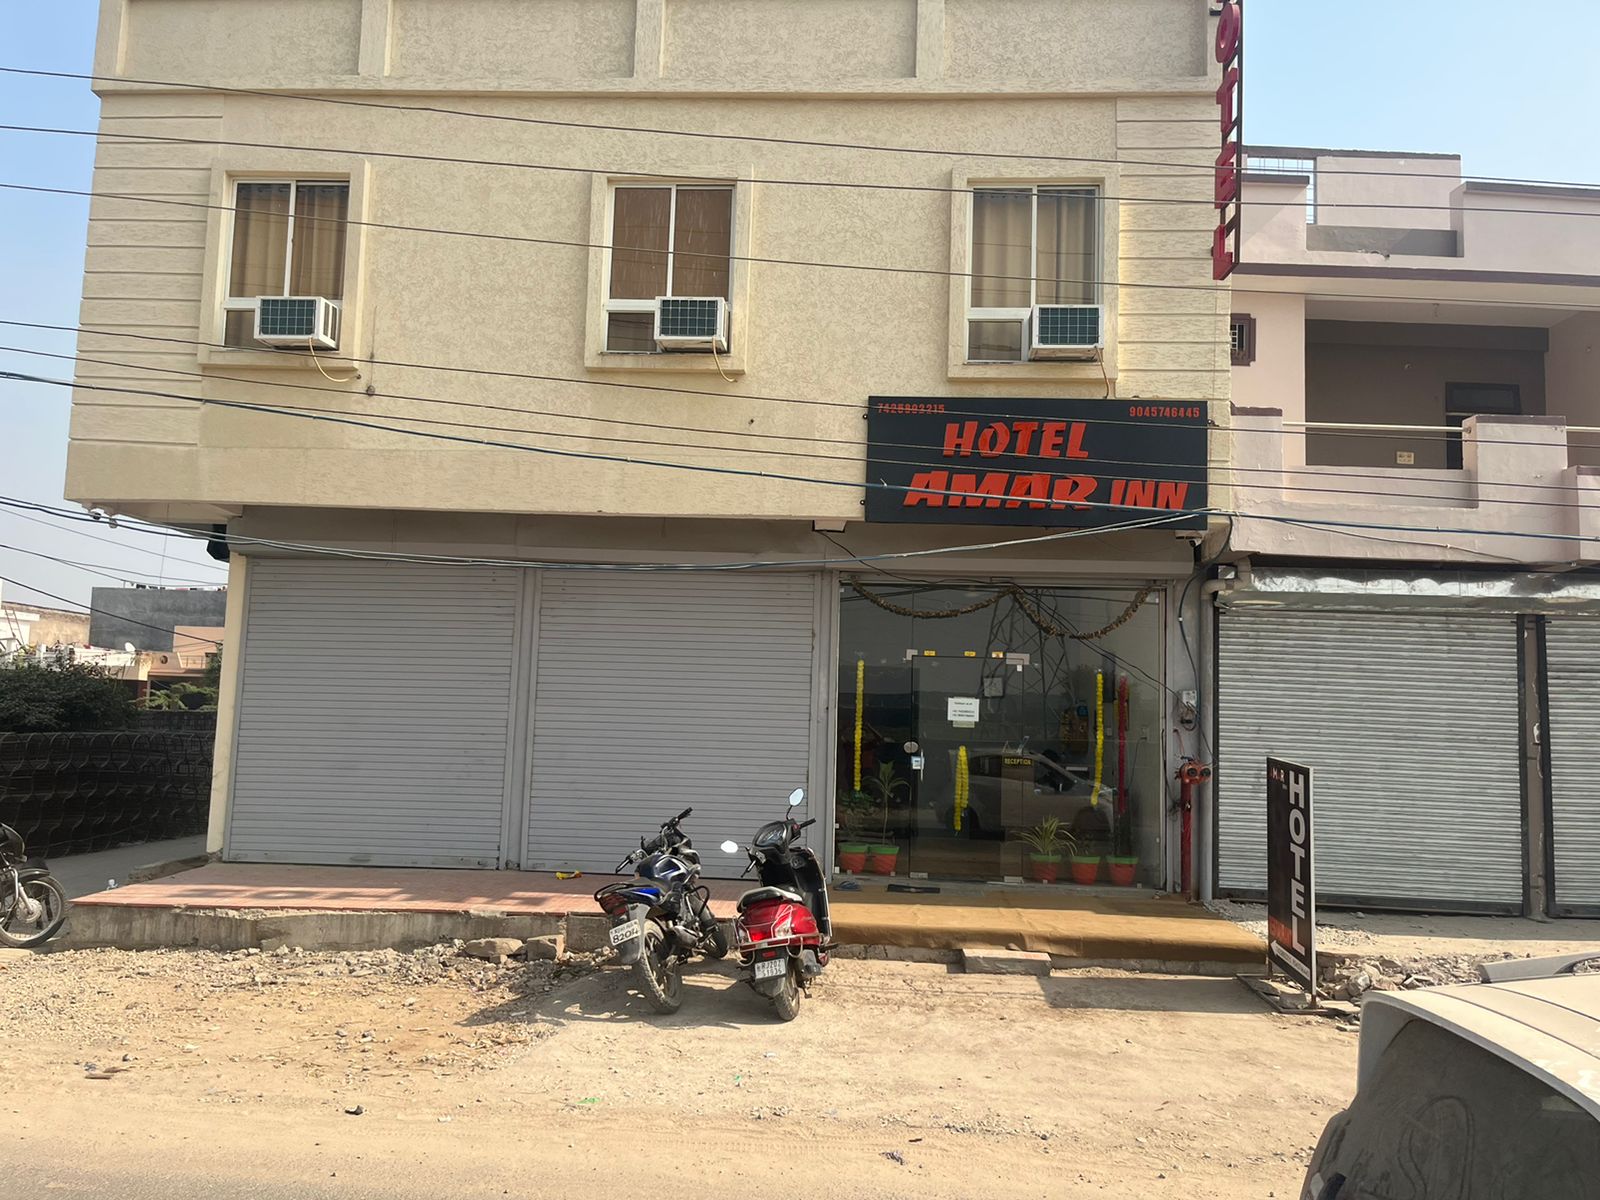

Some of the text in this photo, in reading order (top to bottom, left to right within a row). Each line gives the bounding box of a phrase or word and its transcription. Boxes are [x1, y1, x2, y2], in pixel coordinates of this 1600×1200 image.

[1213, 0, 1240, 280] OTEL
[903, 470, 1189, 511] AMAR INN
[943, 421, 1088, 459] HOTEL
[1289, 770, 1305, 956] HOTEL
